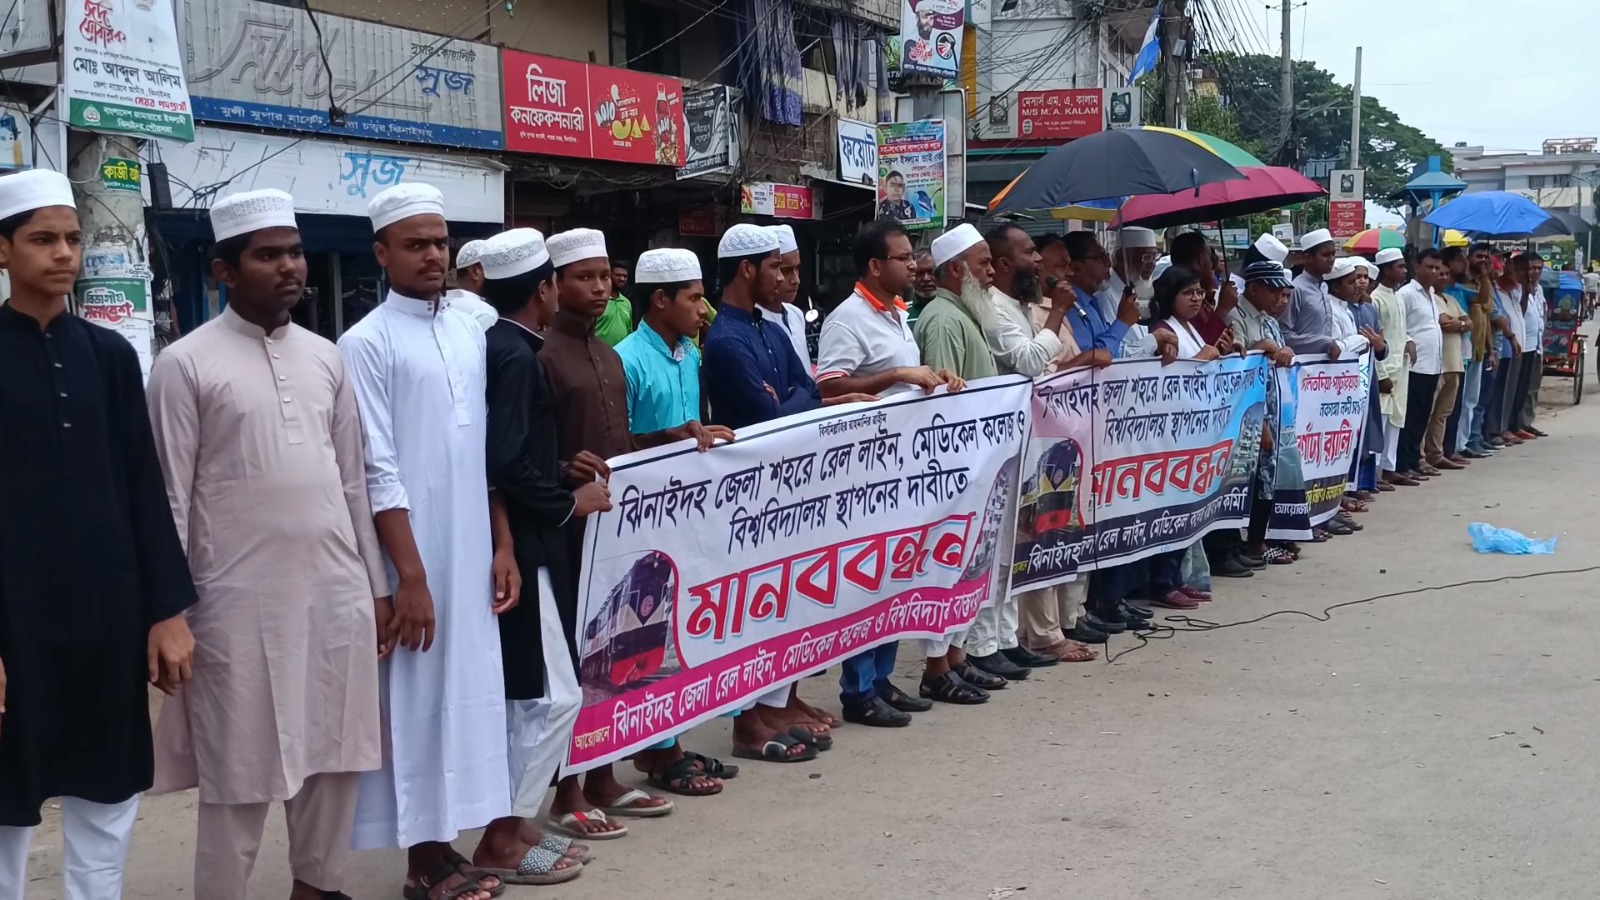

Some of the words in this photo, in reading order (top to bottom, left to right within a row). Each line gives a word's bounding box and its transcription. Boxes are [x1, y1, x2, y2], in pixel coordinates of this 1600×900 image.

[73, 57, 98, 75] মোঃ
[102, 61, 140, 85] আব্দুল
[143, 67, 182, 90] আলিম
[526, 63, 566, 107] লিজা
[251, 109, 283, 122] সুপার
[510, 105, 584, 132] কনফেকশনারী
[1022, 108, 1038, 116] M/S
[1065, 107, 1099, 115] KALAM
[1075, 95, 1099, 105] কালাম
[103, 161, 128, 181] কাজী
[1131, 374, 1159, 407] শহরে
[1162, 375, 1181, 401] রেল
[1182, 366, 1212, 404] লাইন,
[1103, 406, 1169, 445] বিশ্ববিদ্যালয়
[1171, 408, 1211, 444] স্থাপনের
[617, 475, 712, 538] ঝিনাইদহ
[715, 461, 765, 510] জেলা
[769, 451, 818, 495] শহরে
[820, 443, 855, 482] রেল
[858, 425, 904, 472] লাইন,
[913, 413, 978, 460] মেডিকেল
[979, 411, 1015, 446] কলেজ
[1088, 439, 1234, 509] মানববন্ধন
[728, 495, 831, 555] বিশ্ববিদ্যালয়
[836, 476, 902, 530] স্থাপনের
[907, 459, 970, 507] দাবীতে
[1027, 539, 1081, 575] ঝিনাইদহ
[1099, 527, 1120, 551] রেল
[1150, 510, 1190, 539] মেডিকেল
[687, 511, 977, 641] মানববন্ধন
[574, 725, 610, 750] আয়োজনে
[613, 690, 676, 744] ঝিনাইদহ
[679, 674, 713, 717] জেলা
[715, 664, 741, 701] রেল
[743, 646, 777, 684] লাইন,
[782, 631, 838, 673] মেডিকেল
[838, 615, 875, 649] কলেজ
[874, 612, 886, 633] ও
